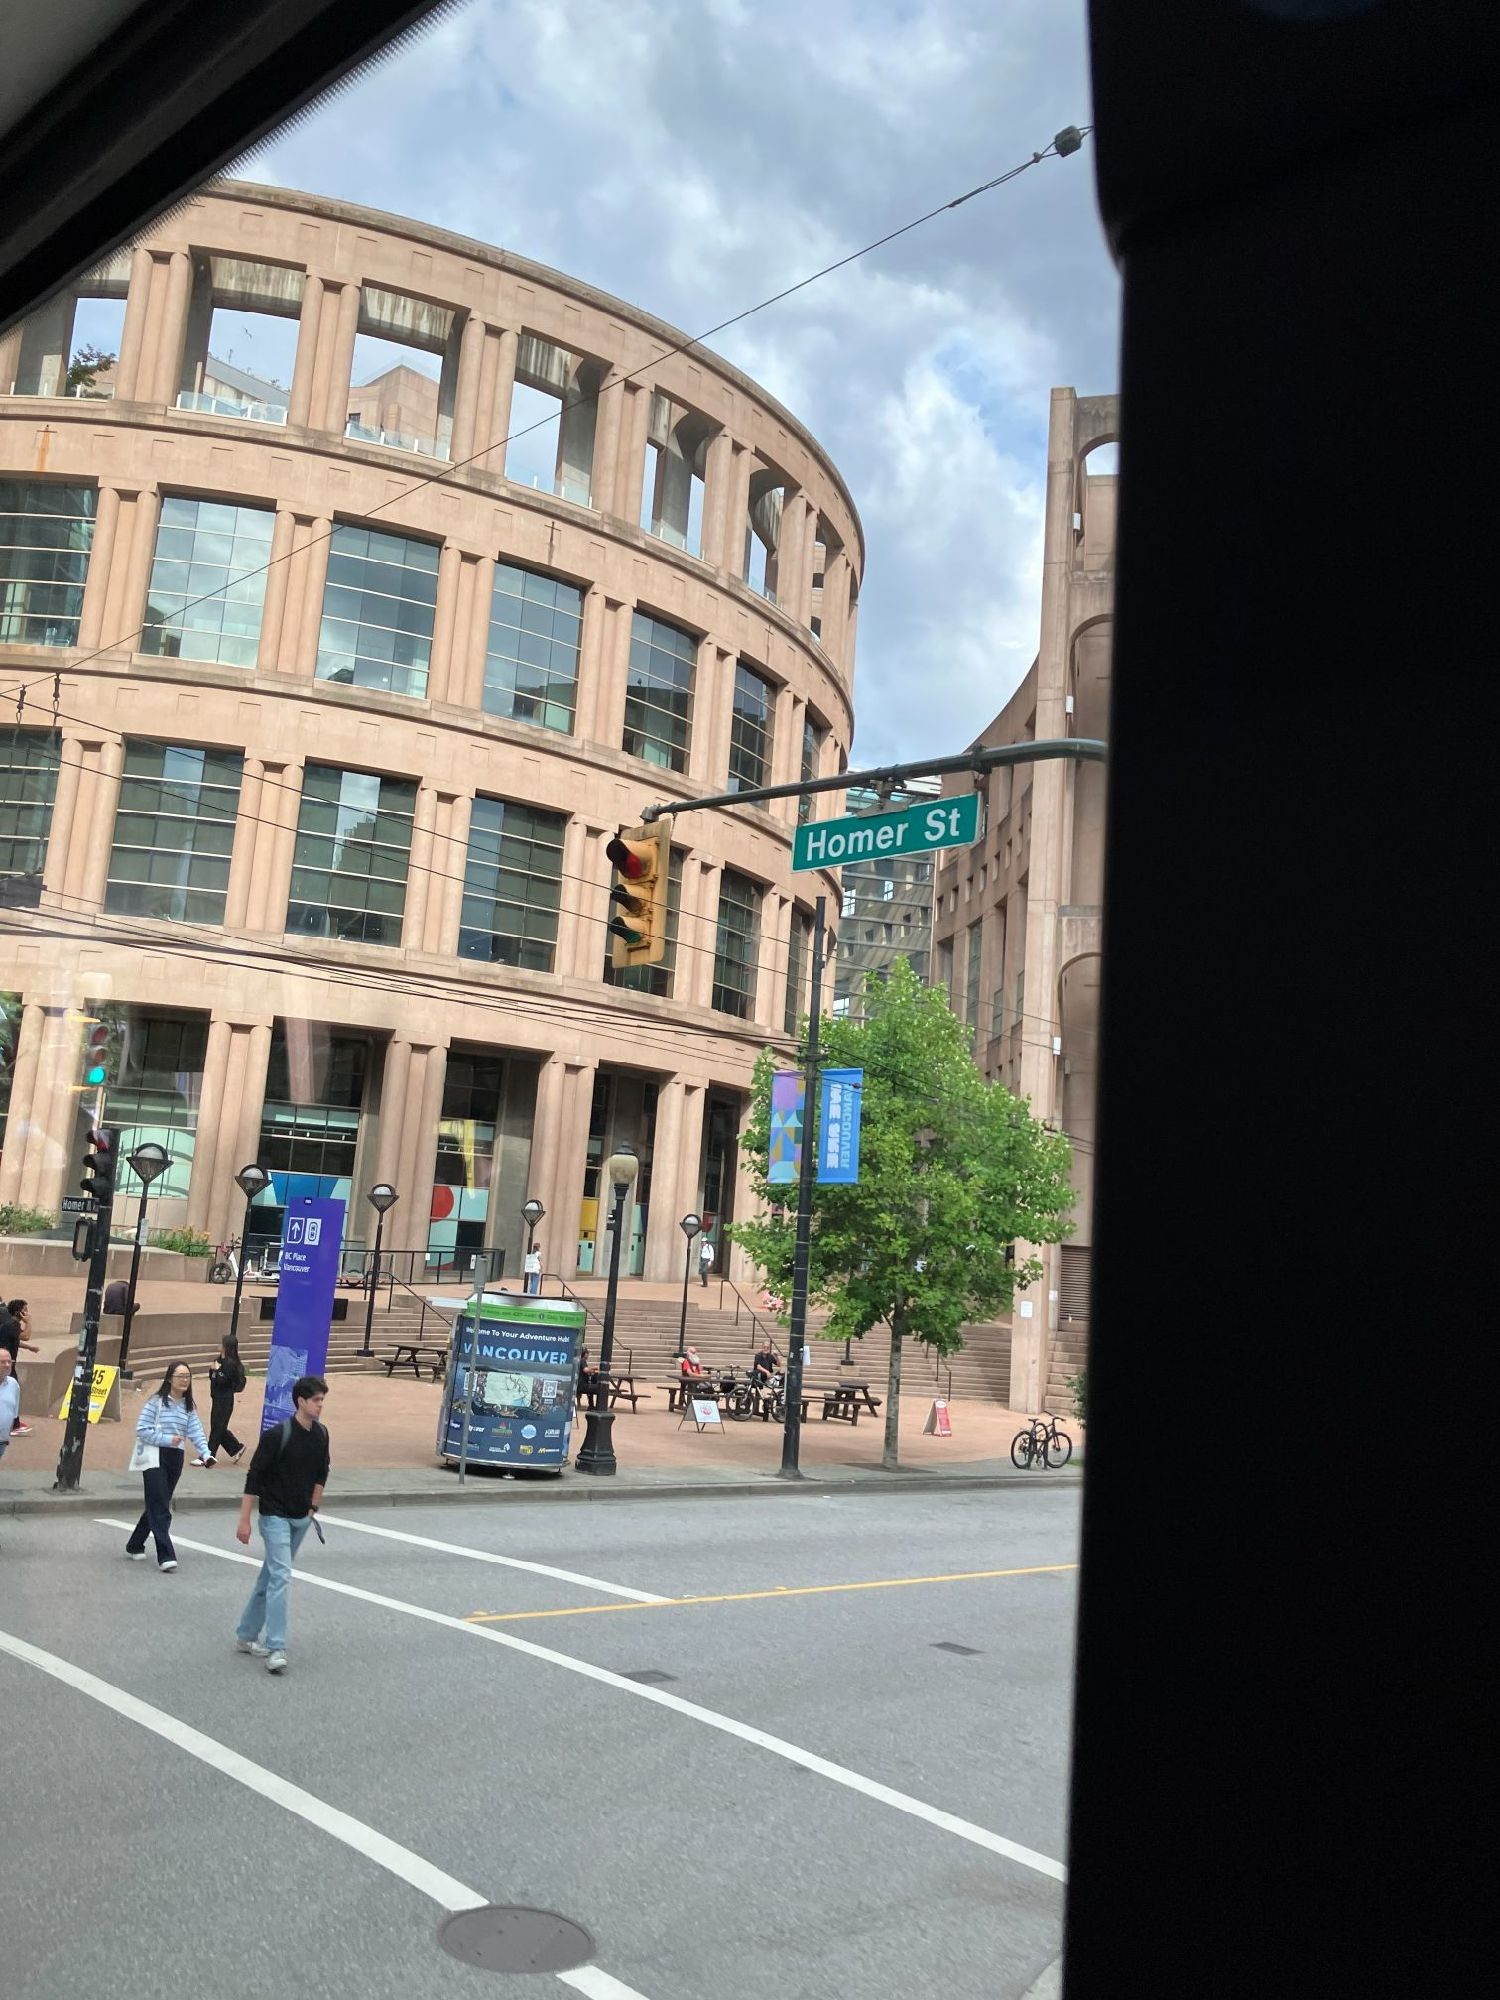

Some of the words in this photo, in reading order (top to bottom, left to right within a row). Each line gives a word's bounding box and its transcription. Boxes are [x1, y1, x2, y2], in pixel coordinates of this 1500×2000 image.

[806, 822, 909, 862] Homer
[924, 807, 961, 842] St
[63, 1199, 85, 1211] Homer
[283, 1263, 311, 1273] Vancouver
[492, 1329, 501, 1338] To
[501, 1330, 518, 1339] Your
[520, 1332, 557, 1342] Adventure
